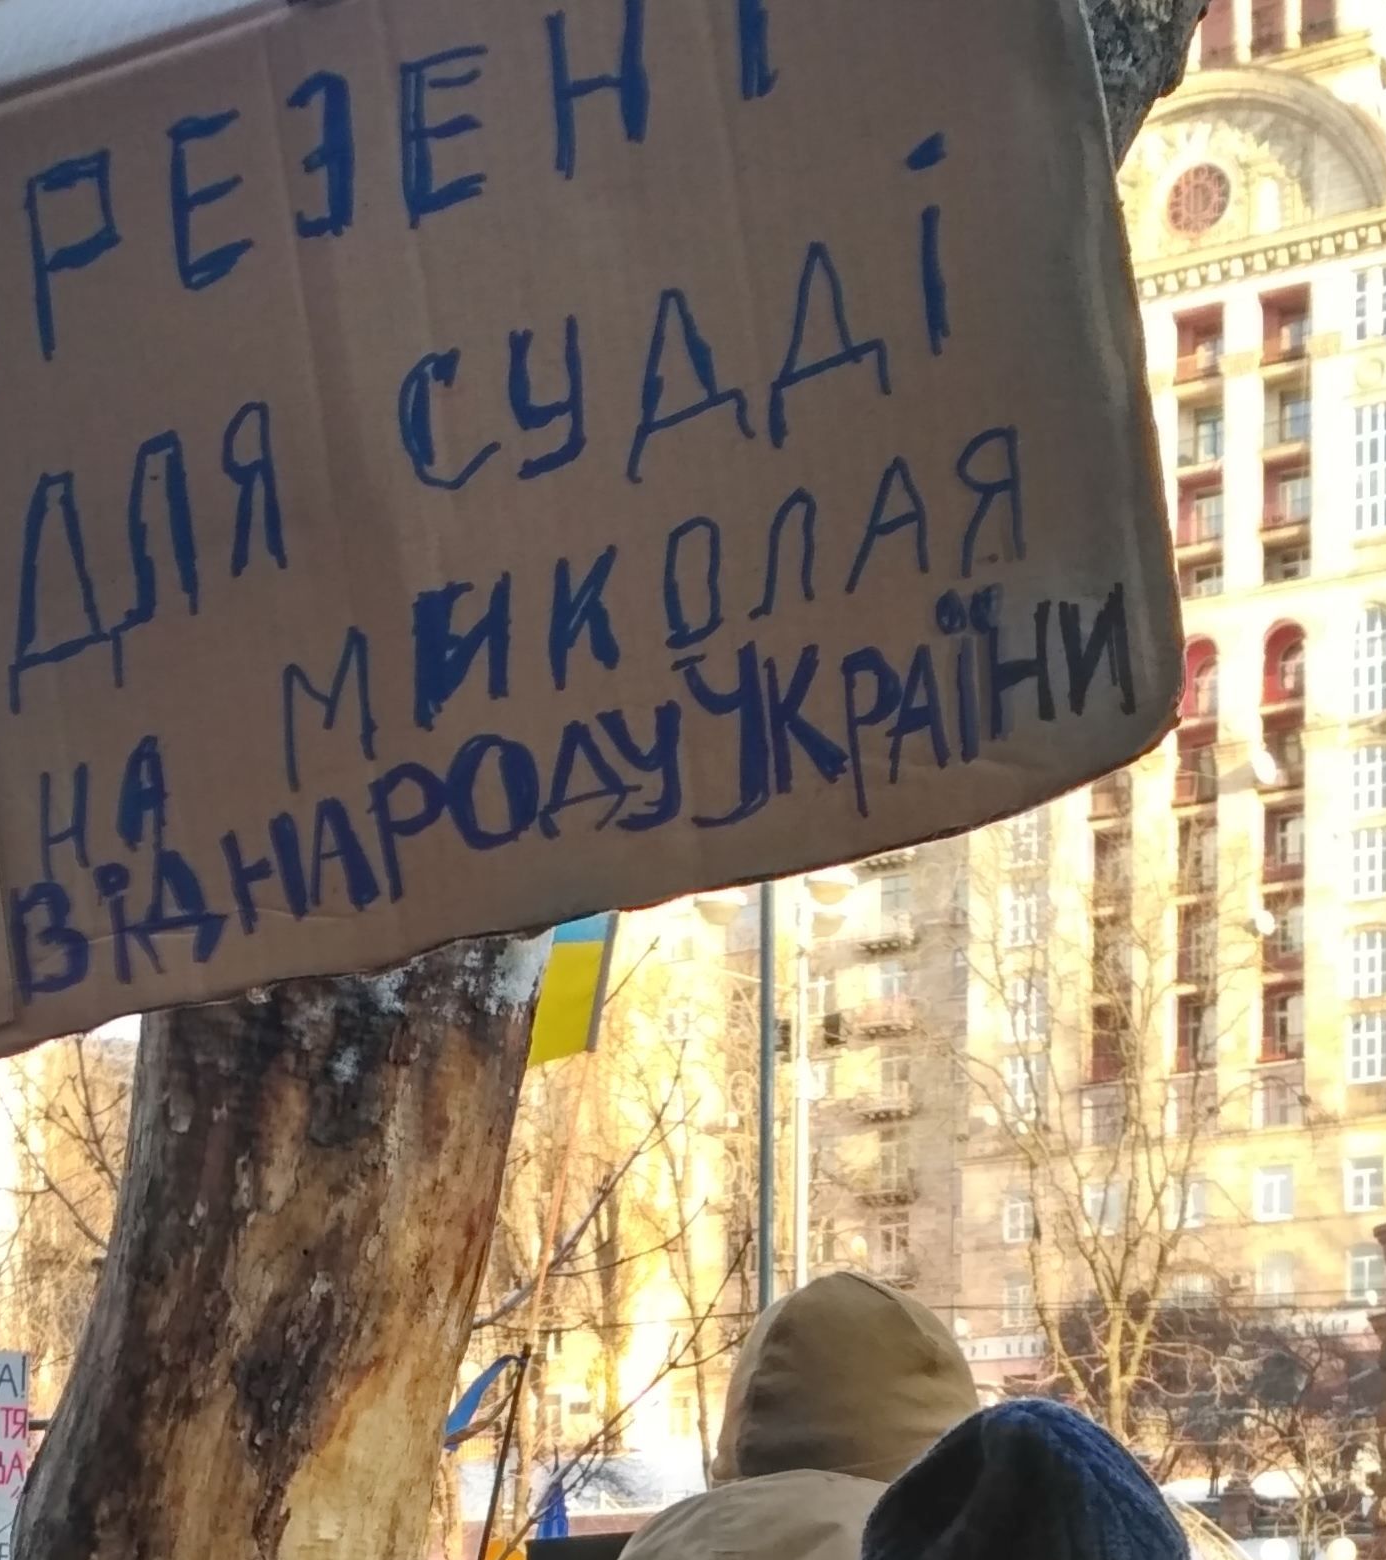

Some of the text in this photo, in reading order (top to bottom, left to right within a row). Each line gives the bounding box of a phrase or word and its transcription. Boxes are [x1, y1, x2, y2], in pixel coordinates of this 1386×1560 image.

[9, 133, 950, 712] ДЛЯ СУДДІ
[40, 426, 1025, 880] НА МИКОЛАЯ
